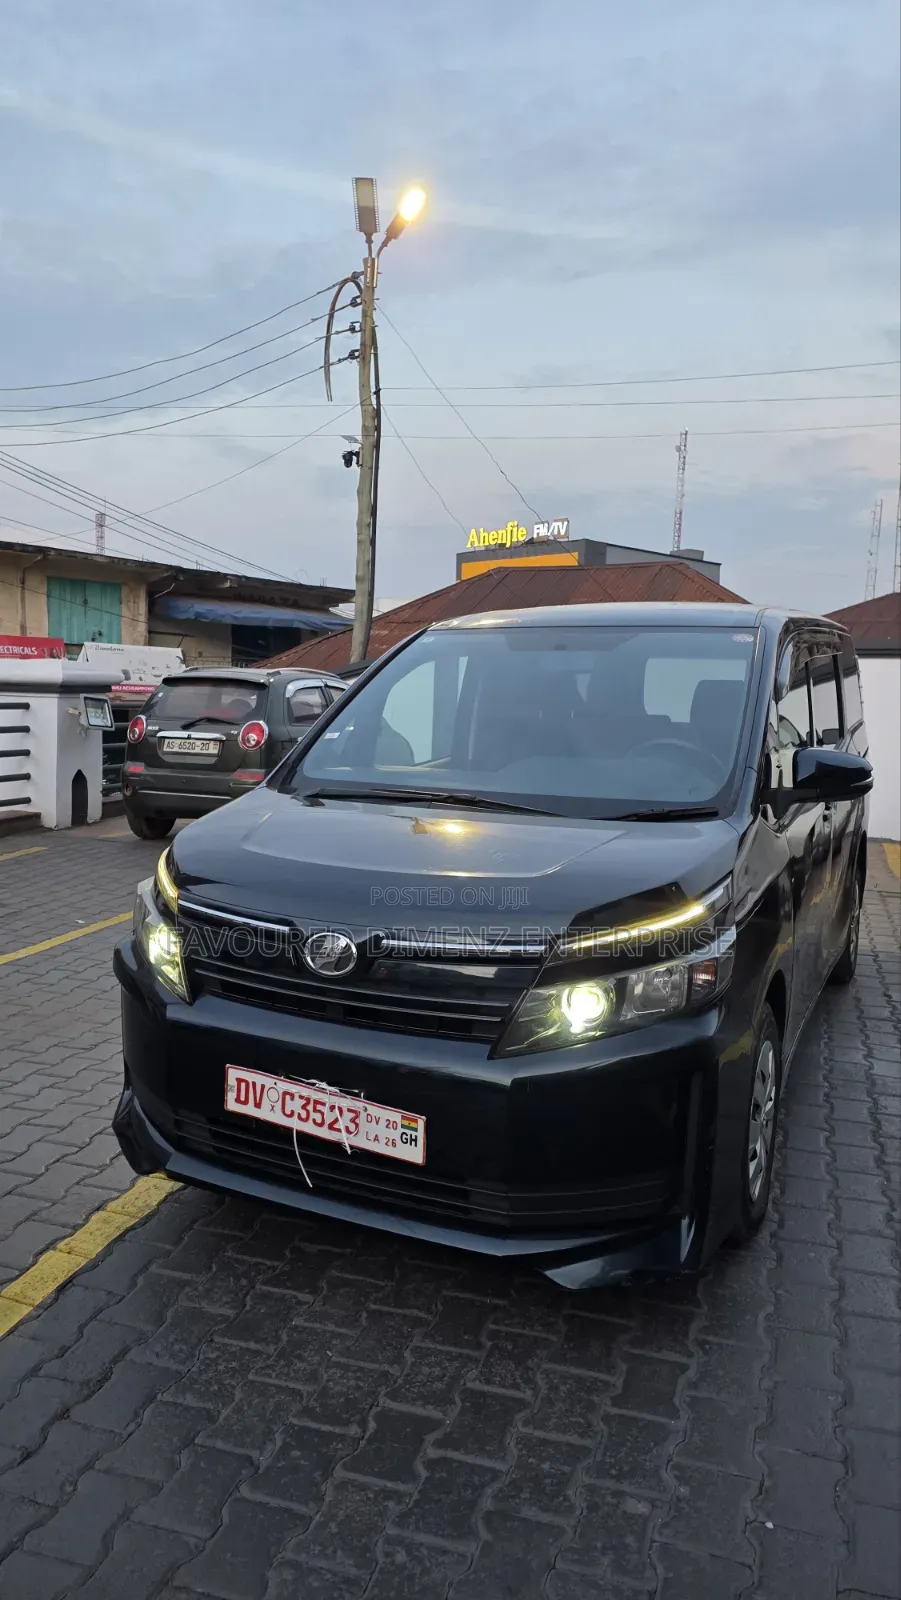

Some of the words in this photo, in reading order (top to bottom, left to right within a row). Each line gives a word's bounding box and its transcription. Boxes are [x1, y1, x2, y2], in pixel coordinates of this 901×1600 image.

[466, 521, 527, 548] Ahenfie
[533, 521, 568, 538] FM/TV
[165, 741, 175, 750] AS
[234, 1077, 266, 1110] DV
[281, 1090, 360, 1136] C3523
[366, 1113, 381, 1125] DV
[385, 1118, 398, 1130] 20
[365, 1131, 380, 1143] LA
[384, 1136, 397, 1148] 26
[400, 1131, 418, 1148] GH
